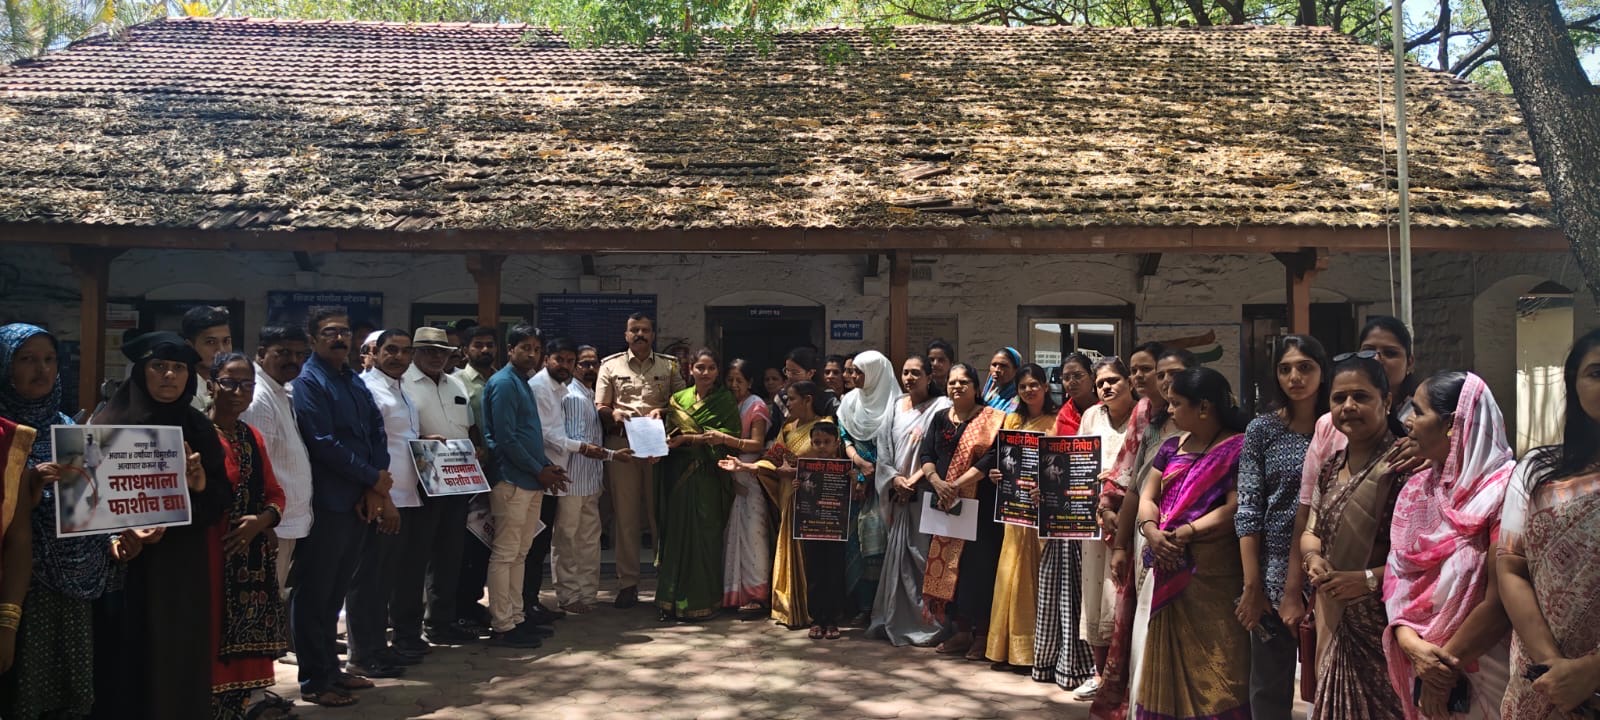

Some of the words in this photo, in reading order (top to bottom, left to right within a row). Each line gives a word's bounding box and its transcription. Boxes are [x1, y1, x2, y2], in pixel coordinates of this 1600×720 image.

[1006, 432, 1024, 444] जाहीर
[1048, 440, 1071, 452] जाहीर
[1073, 439, 1092, 452] निषेध
[441, 464, 476, 475] नराधमाला
[108, 473, 178, 492] नराधमाला
[444, 474, 471, 487] फाशीच
[108, 492, 160, 515] फाशीच
[162, 494, 186, 511] द्या!
